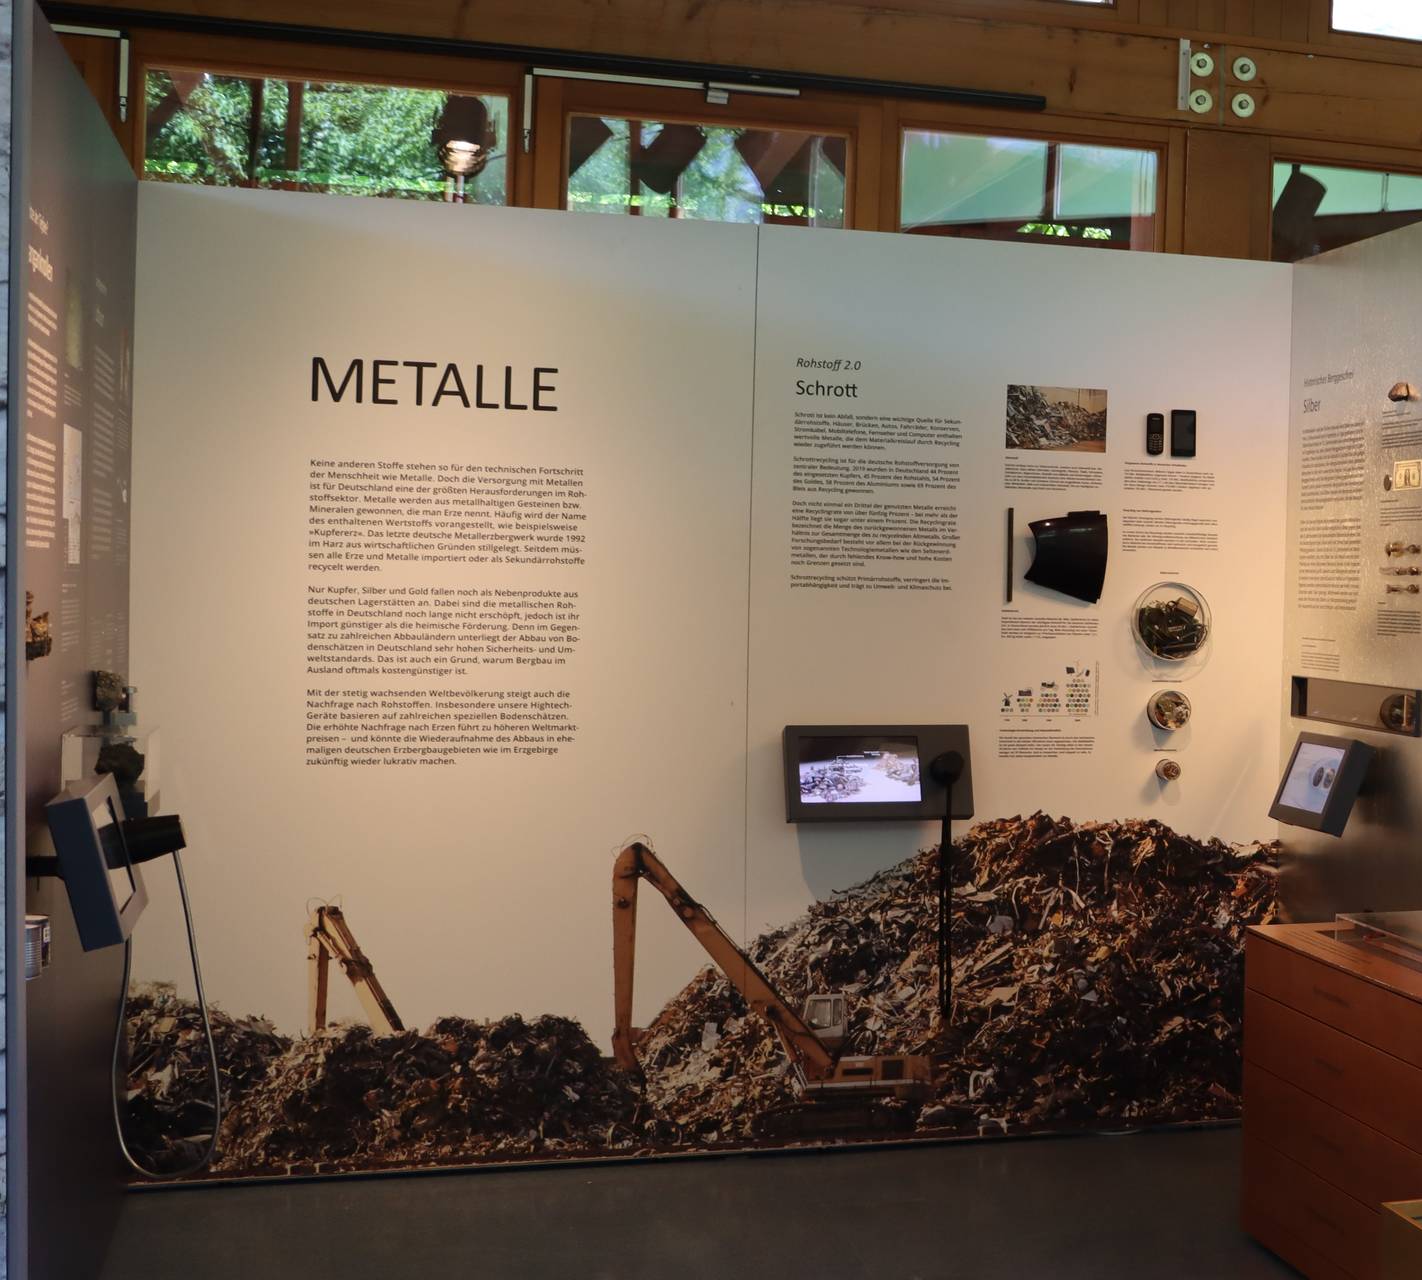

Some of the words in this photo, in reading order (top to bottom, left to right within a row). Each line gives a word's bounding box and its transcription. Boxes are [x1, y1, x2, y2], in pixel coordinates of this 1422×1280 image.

[797, 358, 842, 371] Rohstoff
[844, 360, 862, 370] 2.0
[311, 357, 558, 411] METALLE
[796, 380, 858, 398] Schrott
[1303, 399, 1321, 413] Silber
[310, 458, 335, 468] Keine
[337, 459, 375, 469] anderen
[377, 460, 404, 470] Stoffe
[406, 461, 436, 471] stehen
[450, 462, 463, 472] für
[465, 463, 483, 472] den
[484, 463, 537, 474] technischen
[538, 465, 583, 475] Fortschritt
[309, 470, 325, 479] der
[327, 471, 379, 481] Menschheit
[381, 473, 397, 482] wie
[437, 474, 460, 483] Doch
[461, 474, 475, 484] die
[477, 475, 527, 487] Versorgung
[528, 477, 544, 486] mit
[545, 477, 583, 487] Metallen
[309, 482, 320, 491] ist
[322, 482, 336, 491] für
[337, 482, 393, 493] Deutschland
[394, 484, 414, 493] eine
[415, 484, 431, 494] der
[432, 485, 467, 497] größten
[554, 489, 566, 497] im
[363, 494, 397, 504] Metalle
[398, 495, 432, 505] werden
[516, 499, 560, 509] Gesteinen
[308, 504, 354, 515] Mineralen
[406, 507, 420, 516] die
[443, 508, 462, 517] Erze
[494, 509, 522, 521] Häufig
[523, 510, 543, 519] wird
[544, 510, 559, 520] der
[561, 511, 586, 520] Name
[308, 516, 325, 525] des
[327, 516, 383, 527] enthaltenen
[385, 518, 433, 528] Wertstoffs
[497, 521, 513, 530] wie
[367, 529, 384, 538] Das
[385, 529, 410, 539] letzte
[412, 530, 452, 540] deutsche
[536, 533, 564, 542] wurde
[566, 533, 585, 543] 1992
[308, 540, 320, 548] im
[322, 539, 343, 549] Harz
[436, 542, 476, 551] Gründen
[523, 544, 559, 553] Seitdem
[326, 551, 343, 560] alle
[344, 551, 364, 561] Erze
[366, 552, 384, 561] und
[386, 552, 419, 562] Metalle
[420, 554, 466, 565] importiert
[468, 554, 488, 563] oder
[490, 554, 503, 563] als
[308, 562, 343, 574] recycelt
[306, 688, 322, 697] Mit
[324, 688, 339, 697] der
[342, 689, 368, 699] stetig
[369, 688, 427, 697] wachsenden
[506, 690, 531, 700] steigt
[533, 689, 555, 698] auch
[556, 689, 570, 698] die
[306, 699, 354, 711] Nachfrage
[356, 700, 378, 709] nach
[306, 711, 337, 720] Geräte
[339, 711, 380, 720] basieren
[381, 711, 397, 720] auf
[398, 711, 451, 720] zahlreichen
[453, 711, 498, 722] speziellen
